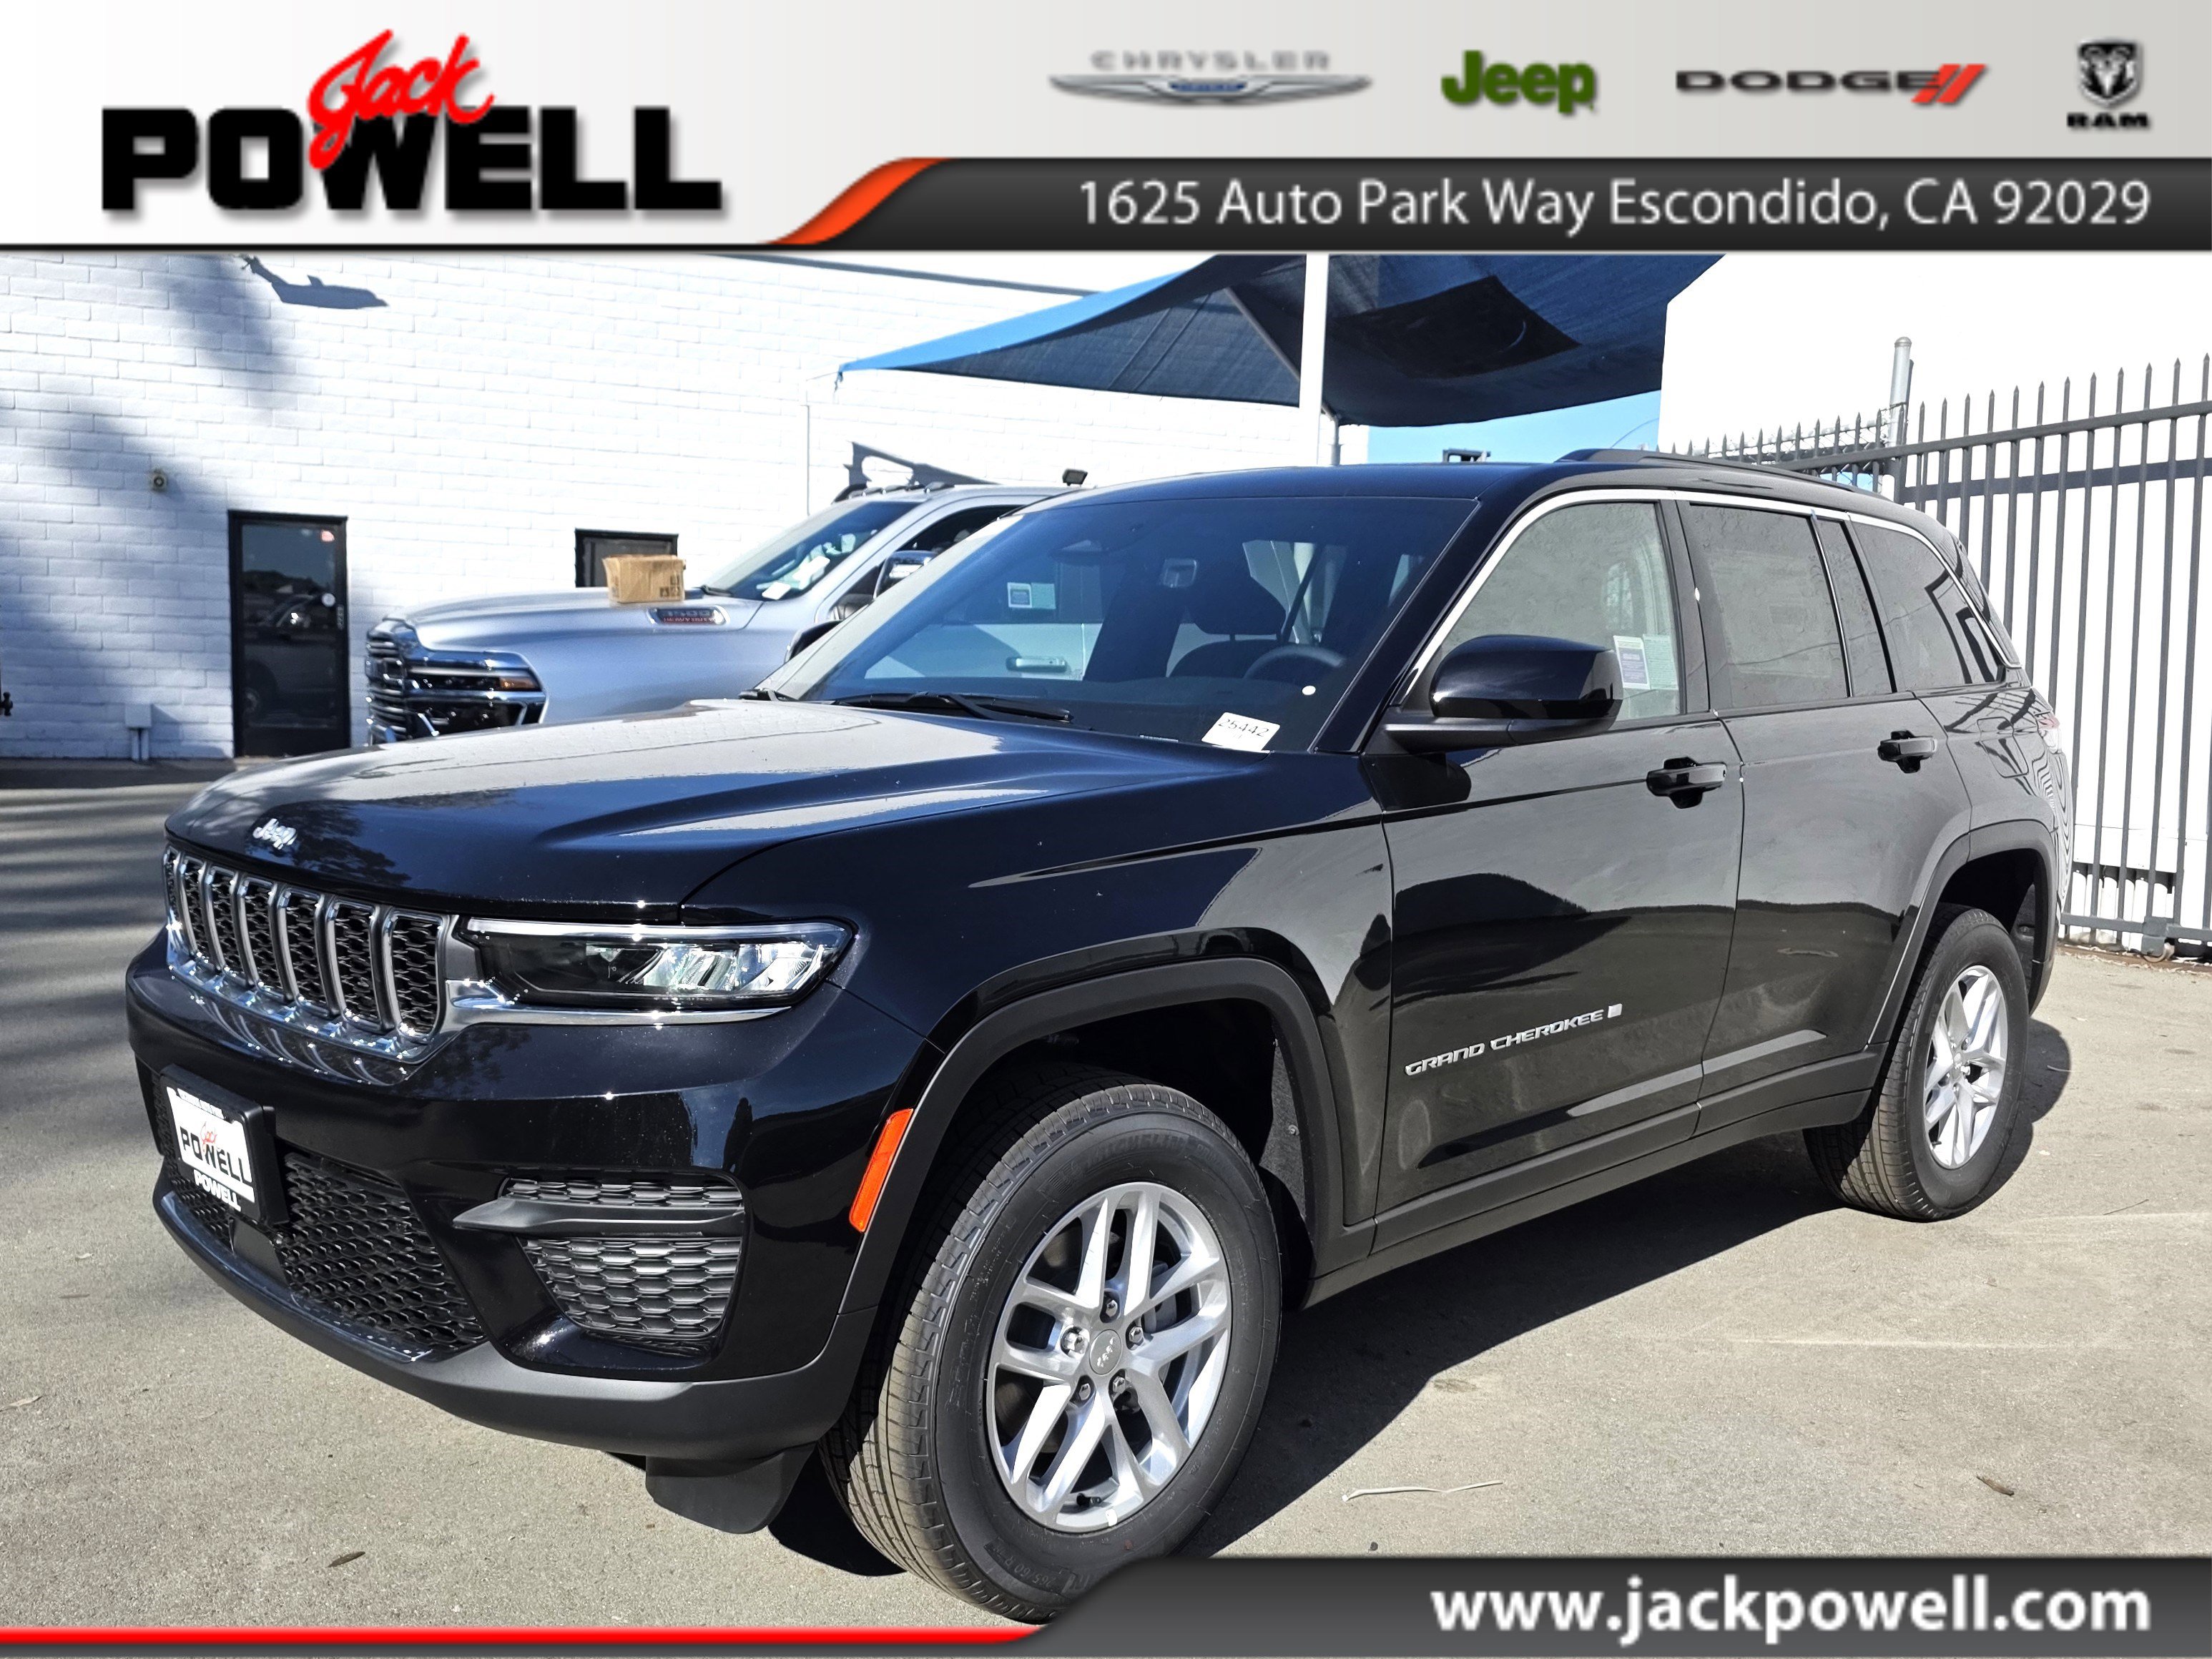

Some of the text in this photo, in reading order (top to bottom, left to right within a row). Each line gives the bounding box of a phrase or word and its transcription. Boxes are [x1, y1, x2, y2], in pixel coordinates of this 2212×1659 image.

[1218, 719, 1269, 737] 25442
[252, 818, 298, 850] Jeep
[1405, 1009, 1604, 1075] GRAND CHEROKEE
[180, 1126, 253, 1183] POWELL
[193, 1169, 241, 1212] POWELL
